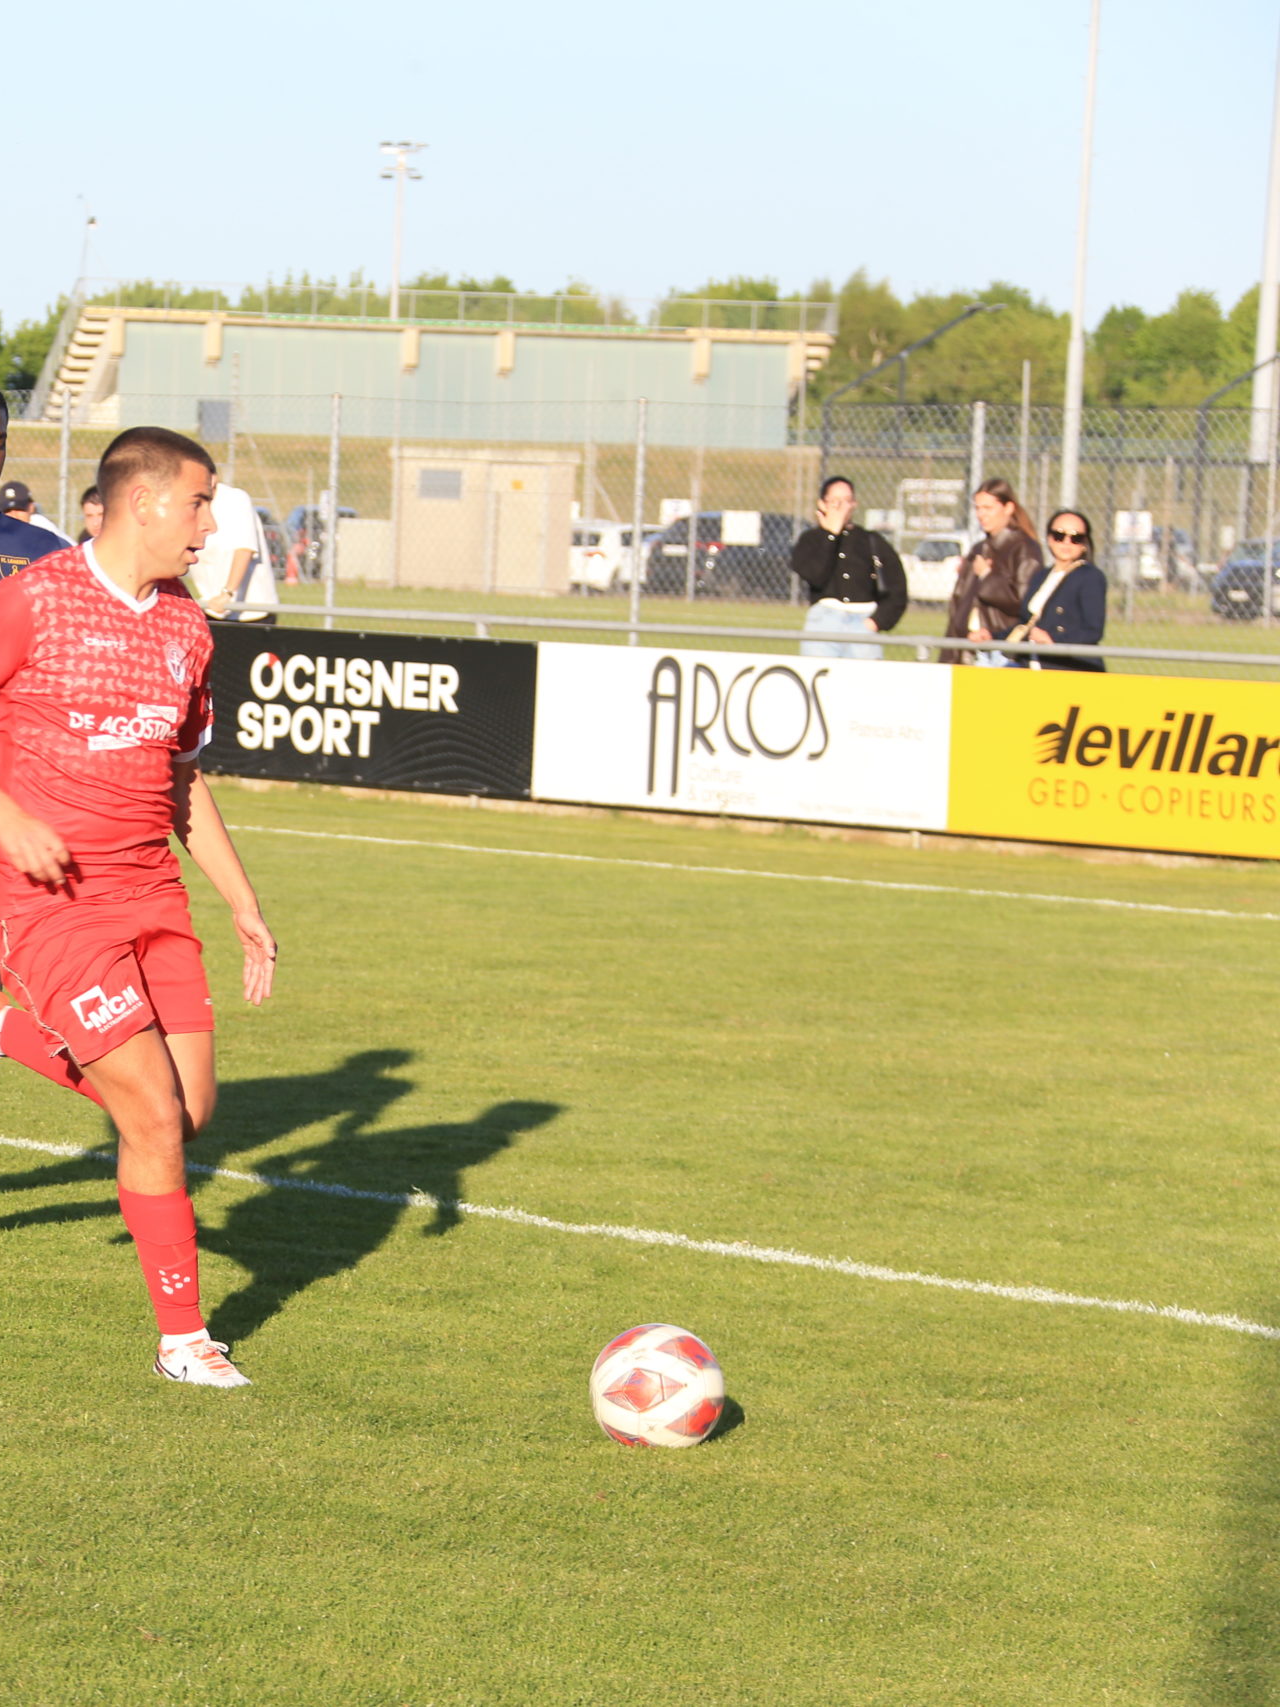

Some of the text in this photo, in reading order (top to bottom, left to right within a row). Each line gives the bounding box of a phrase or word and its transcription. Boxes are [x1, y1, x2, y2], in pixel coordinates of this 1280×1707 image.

[250, 652, 459, 713] OCHSNER
[69, 711, 95, 730] DE
[237, 701, 380, 758] SPORT
[646, 655, 831, 798] ARCOS
[1035, 705, 1280, 778] devillar
[1028, 777, 1277, 824] GED COPIEURS
[87, 985, 141, 1029] MCM
